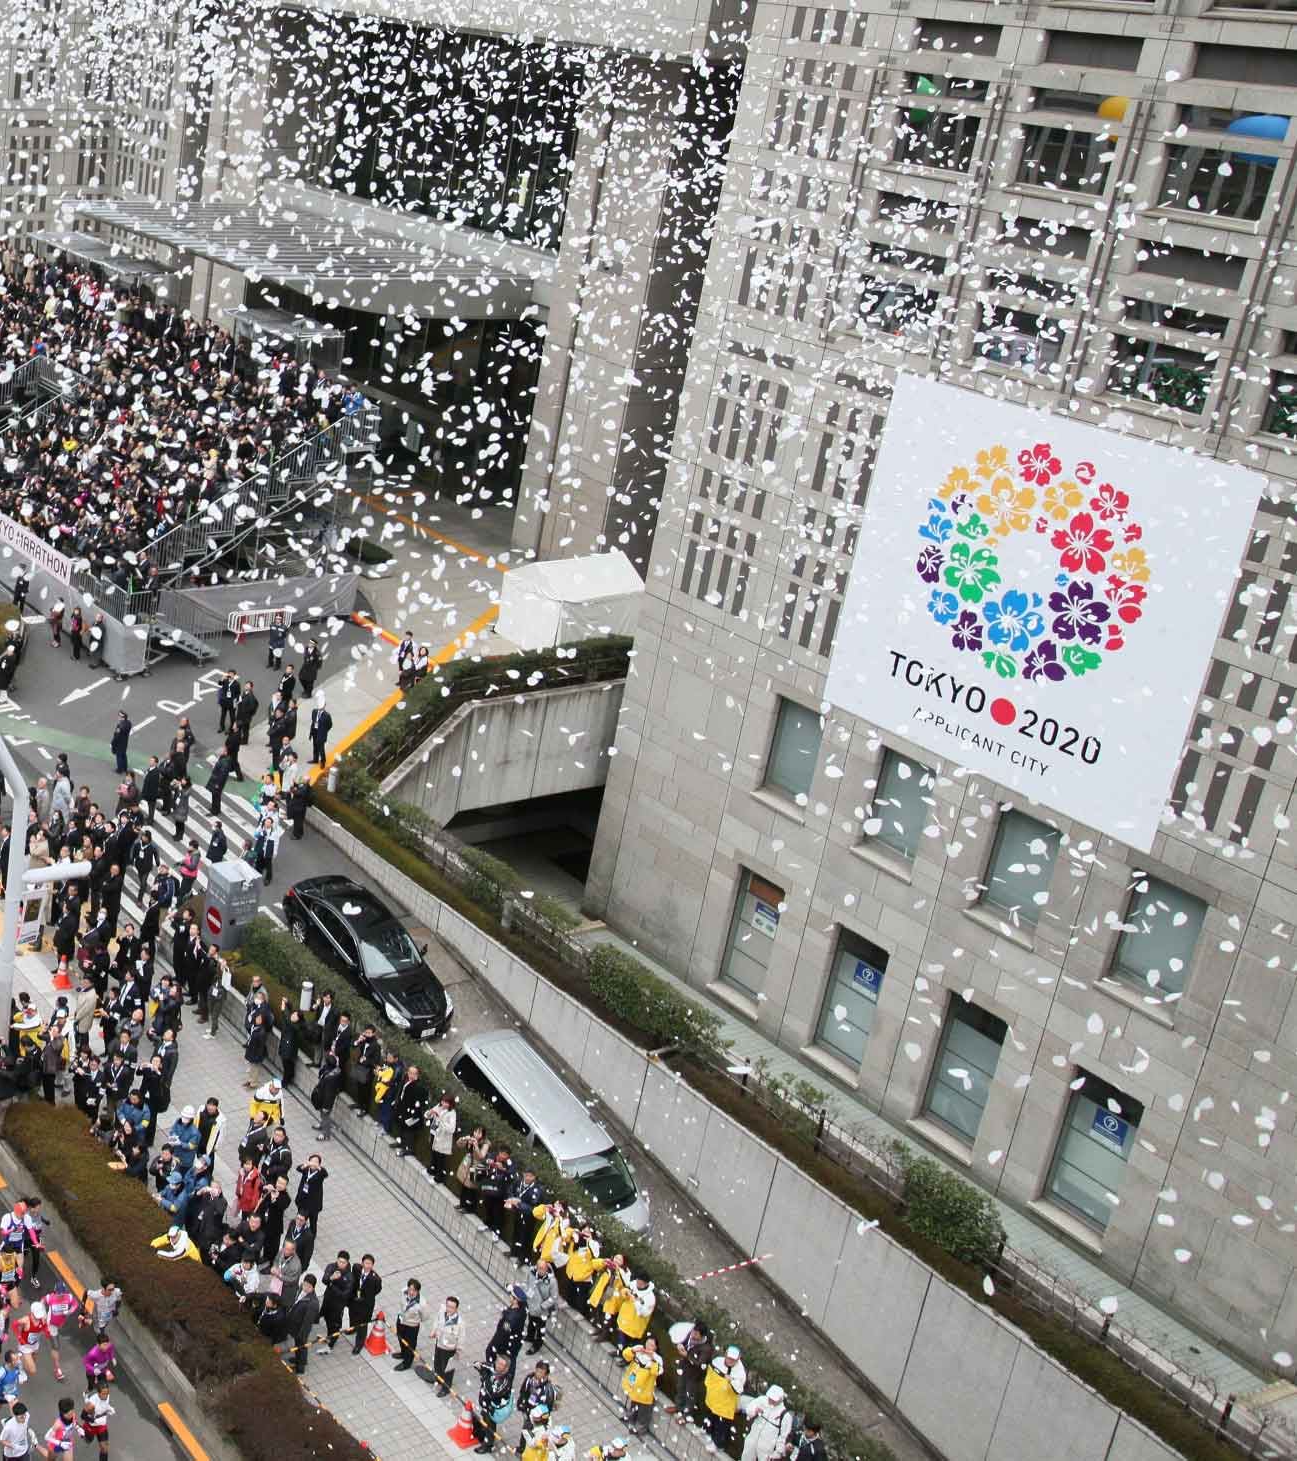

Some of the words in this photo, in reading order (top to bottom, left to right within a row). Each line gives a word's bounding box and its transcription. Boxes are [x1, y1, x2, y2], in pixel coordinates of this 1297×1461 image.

[16, 531, 68, 580] MARATHON
[889, 650, 986, 714] TOKYO
[1018, 709, 1101, 765] 2020
[1010, 750, 1049, 777] CITY
